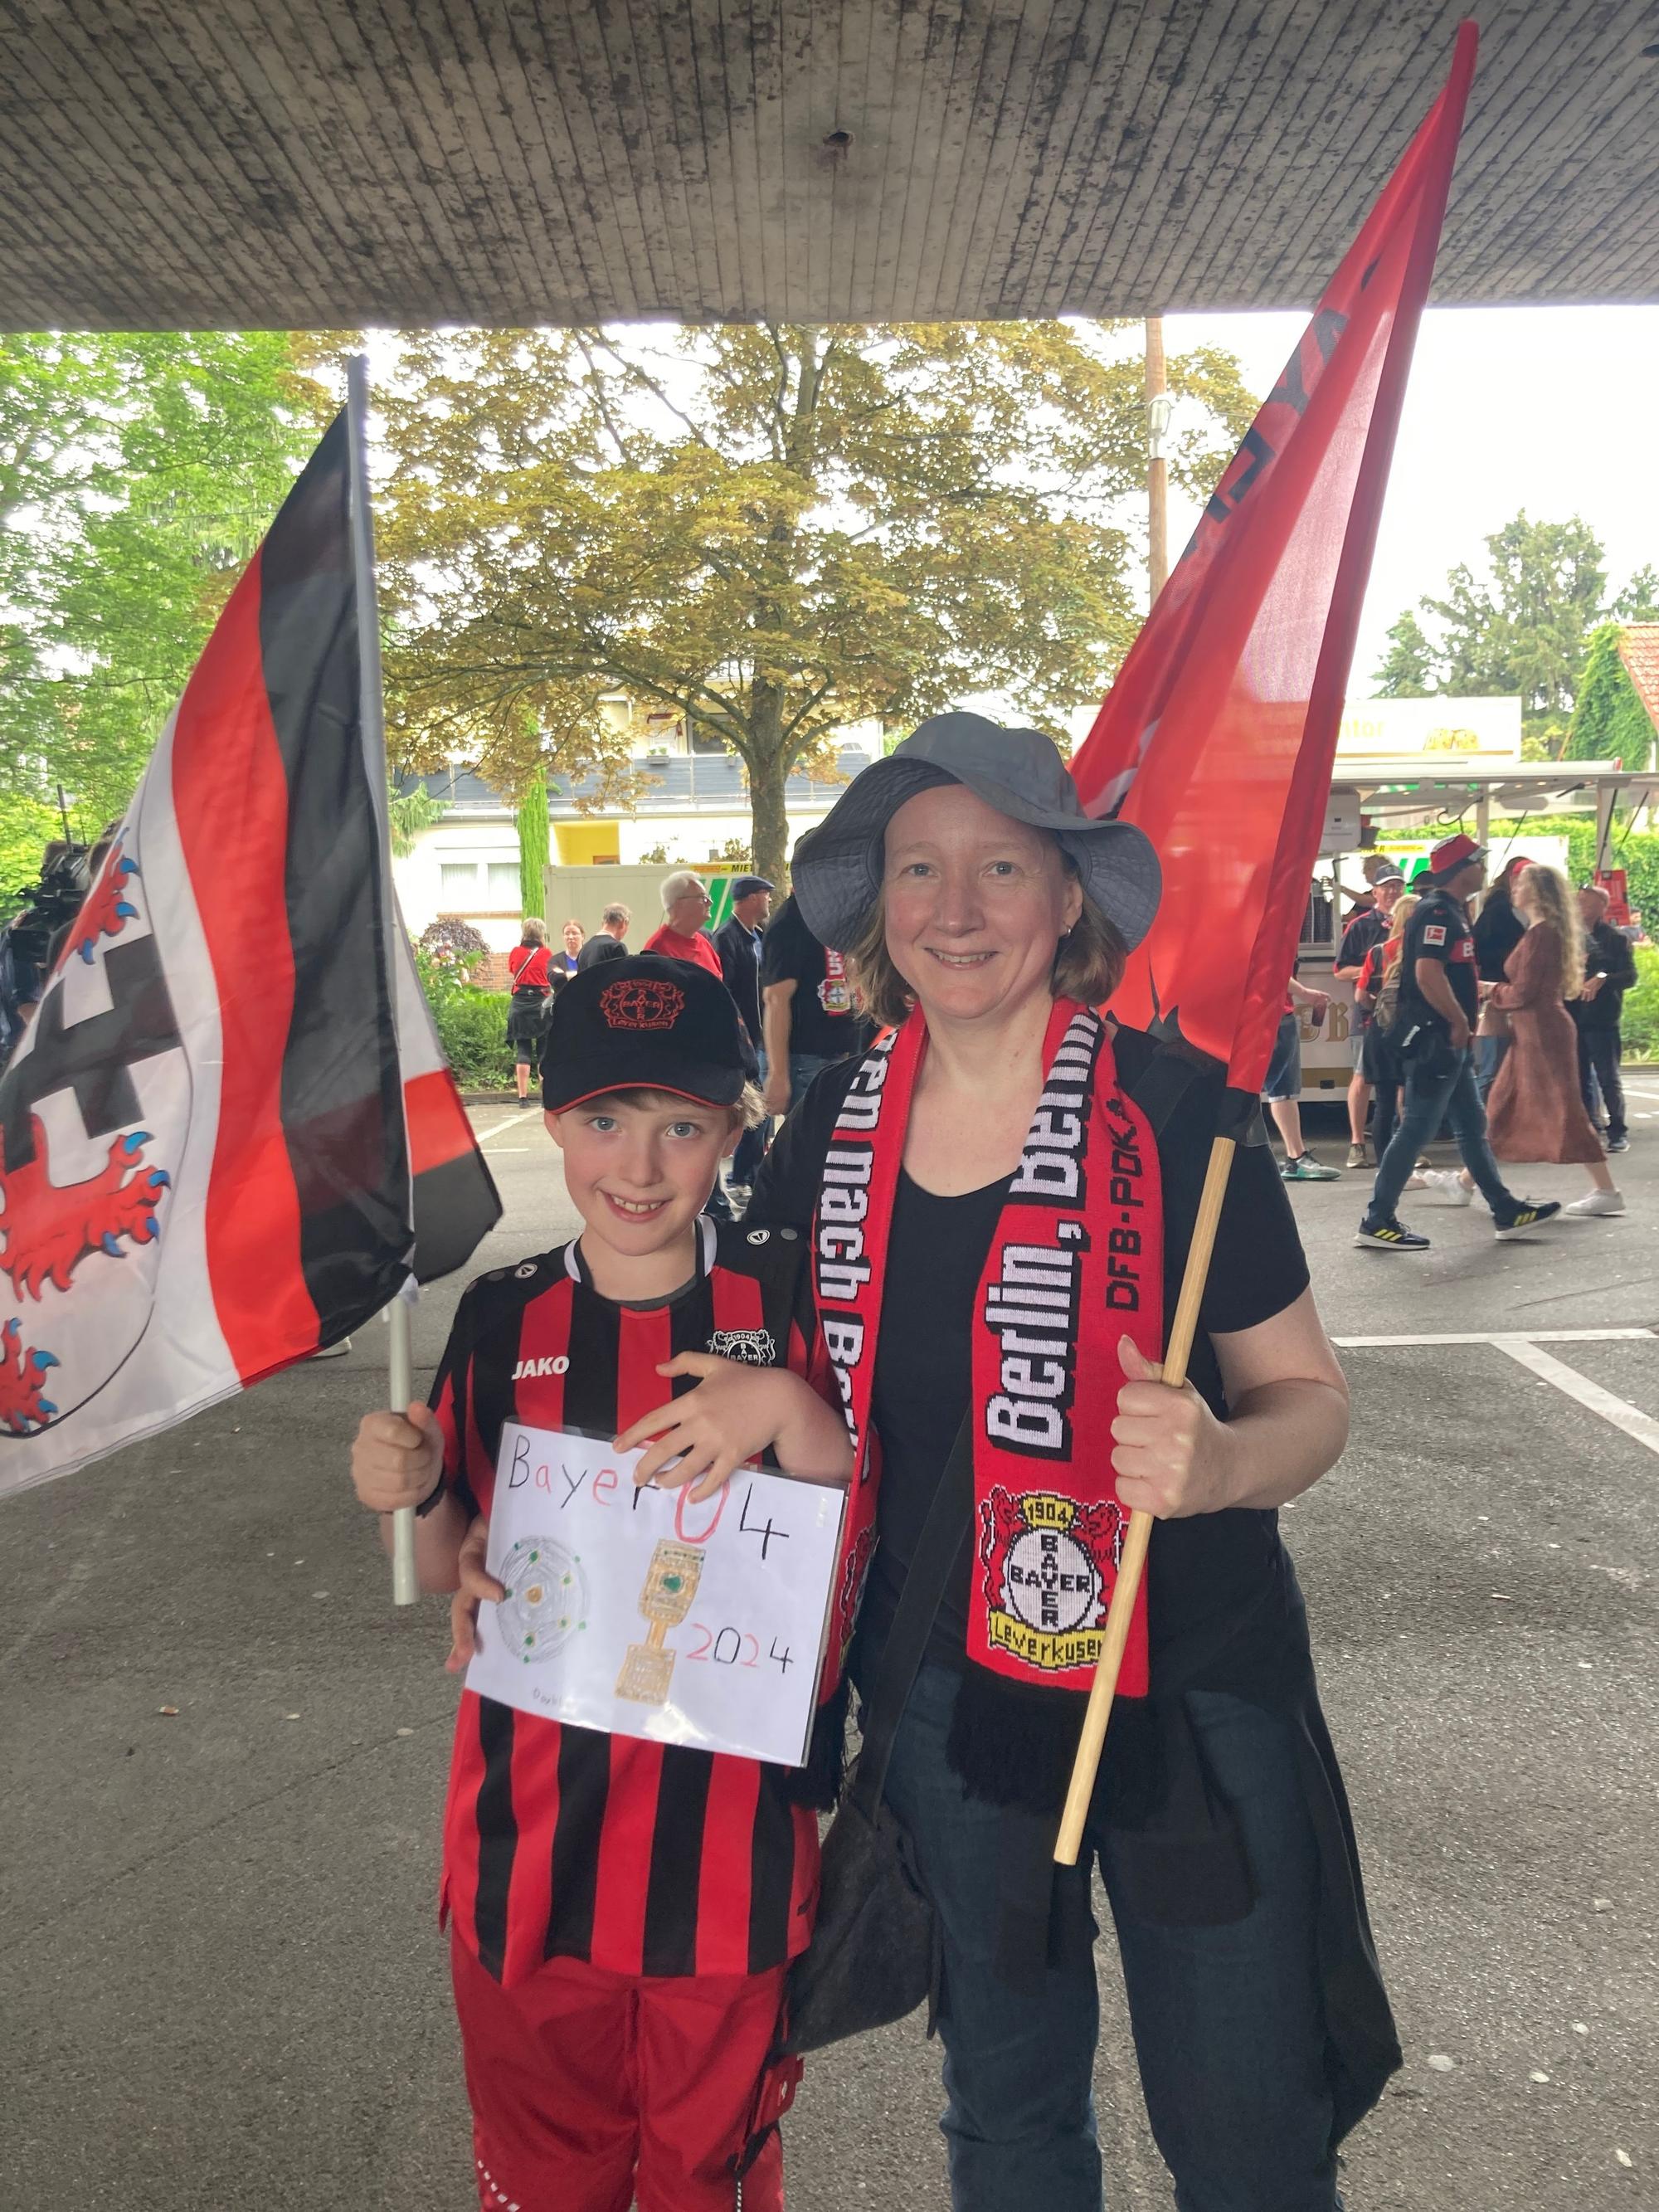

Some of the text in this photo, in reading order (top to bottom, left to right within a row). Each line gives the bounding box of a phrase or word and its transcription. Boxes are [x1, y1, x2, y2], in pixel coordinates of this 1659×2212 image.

[820, 1151, 873, 1300] nach
[511, 1356, 570, 1380] JAKO
[985, 1223, 1082, 1449] Berlin,
[509, 1435, 790, 1561] Bayer 04
[1029, 1502, 1068, 1522] 1904
[1010, 1564, 1092, 1593] BAYER
[1041, 1535, 1058, 1627] BAYER
[686, 1623, 794, 1674] 2024
